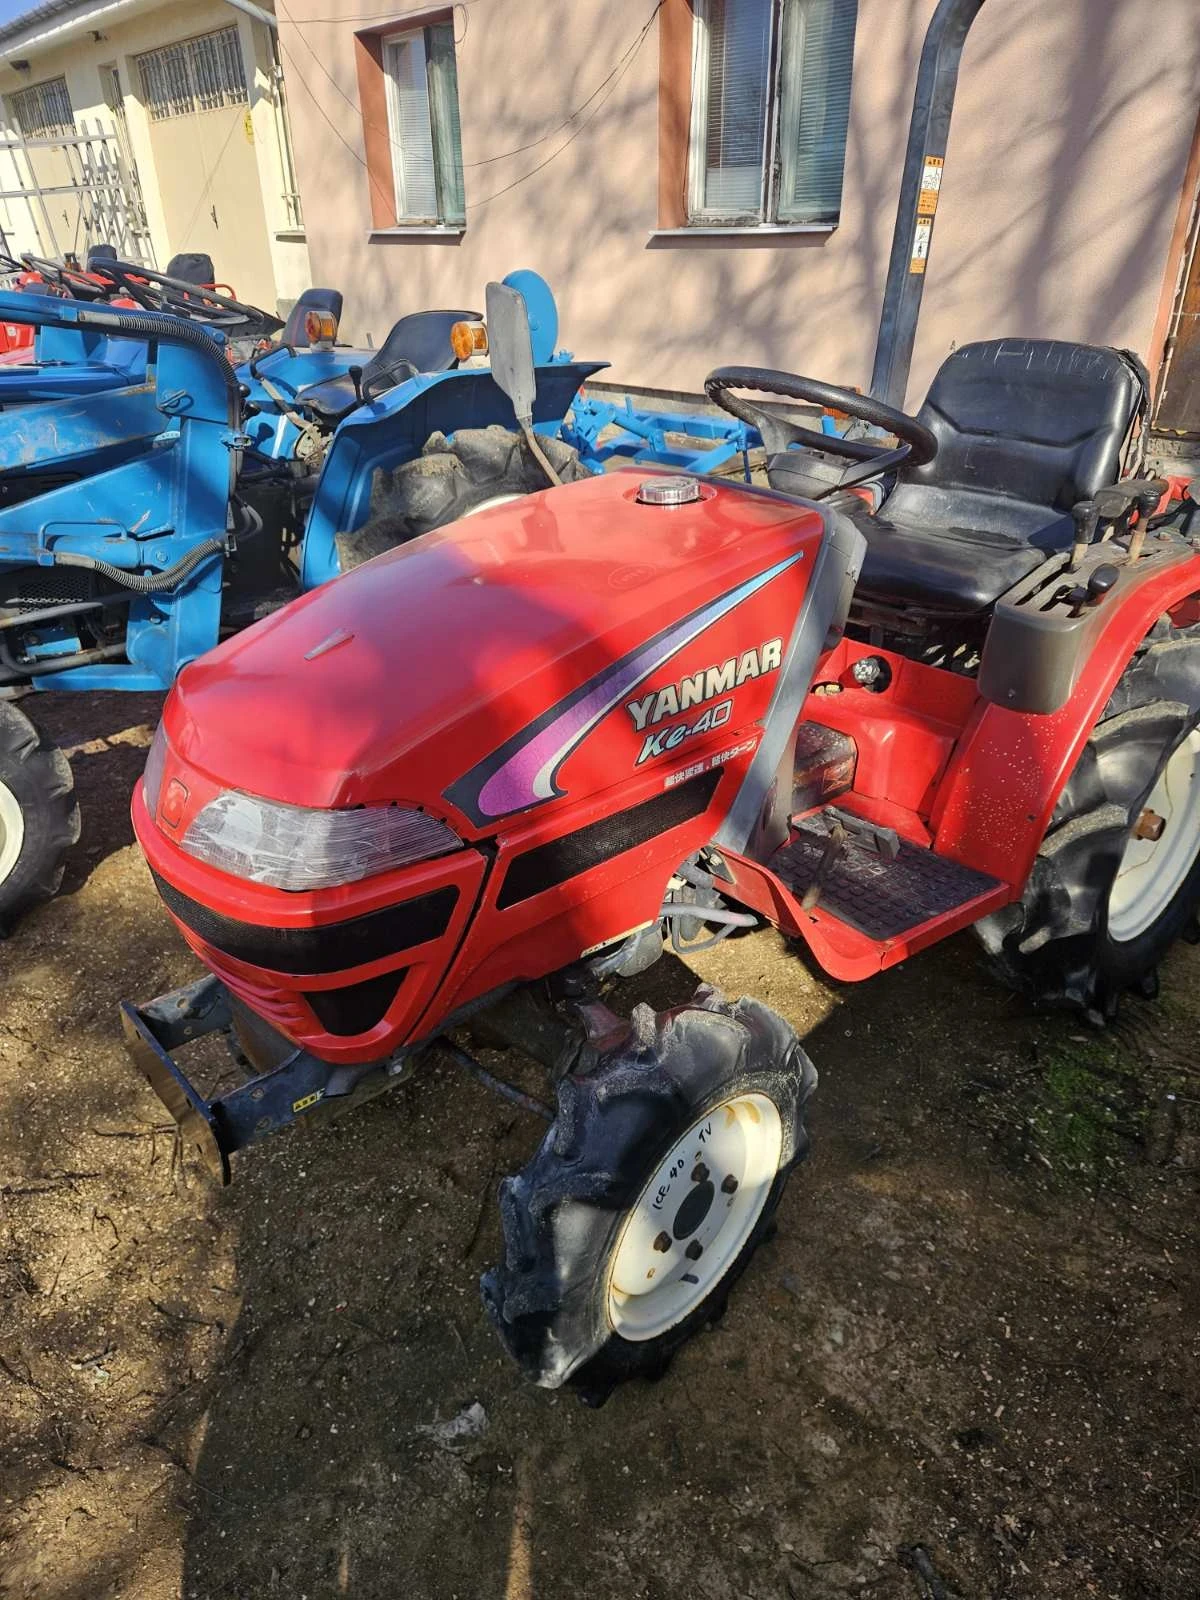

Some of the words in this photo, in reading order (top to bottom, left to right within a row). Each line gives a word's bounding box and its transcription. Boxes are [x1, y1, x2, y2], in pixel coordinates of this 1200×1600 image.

[626, 638, 783, 732] YANMAR
[634, 699, 733, 767] Ke-40
[698, 1121, 712, 1143] TV
